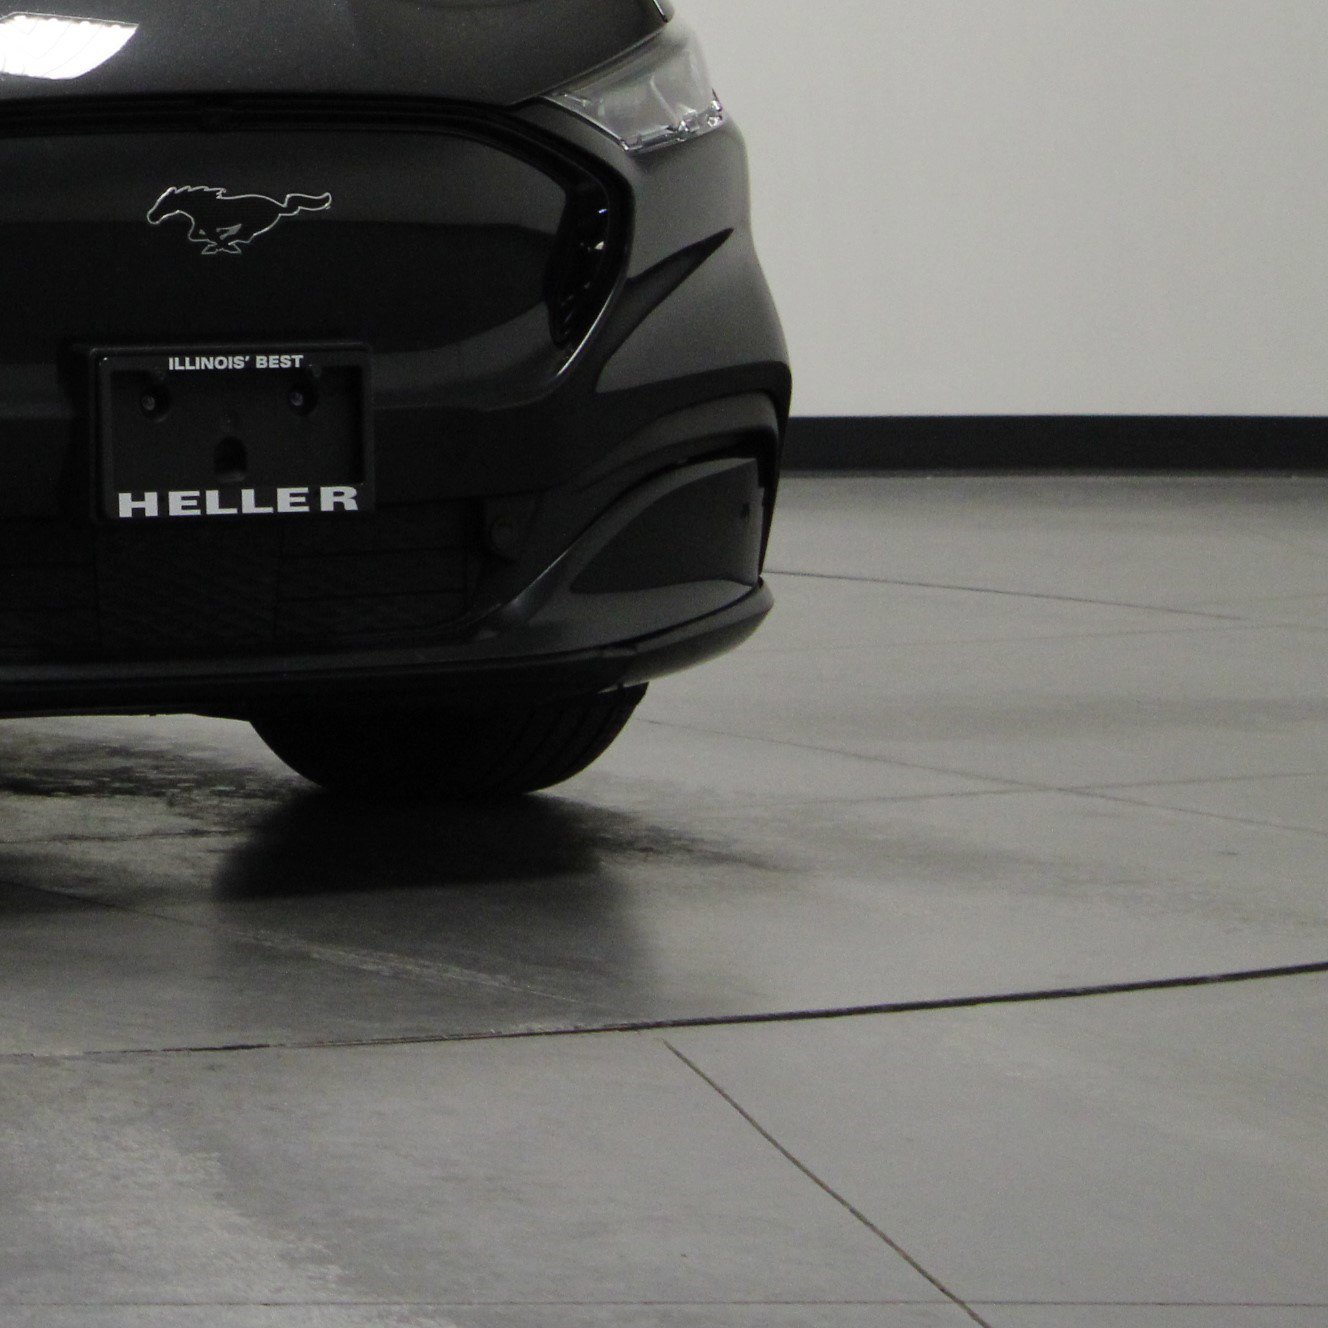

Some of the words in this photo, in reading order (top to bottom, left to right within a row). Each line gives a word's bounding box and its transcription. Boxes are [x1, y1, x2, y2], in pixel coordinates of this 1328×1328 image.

[168, 355, 250, 371] ILLINOIS'
[255, 354, 304, 369] BEST
[118, 485, 359, 518] HELLER
